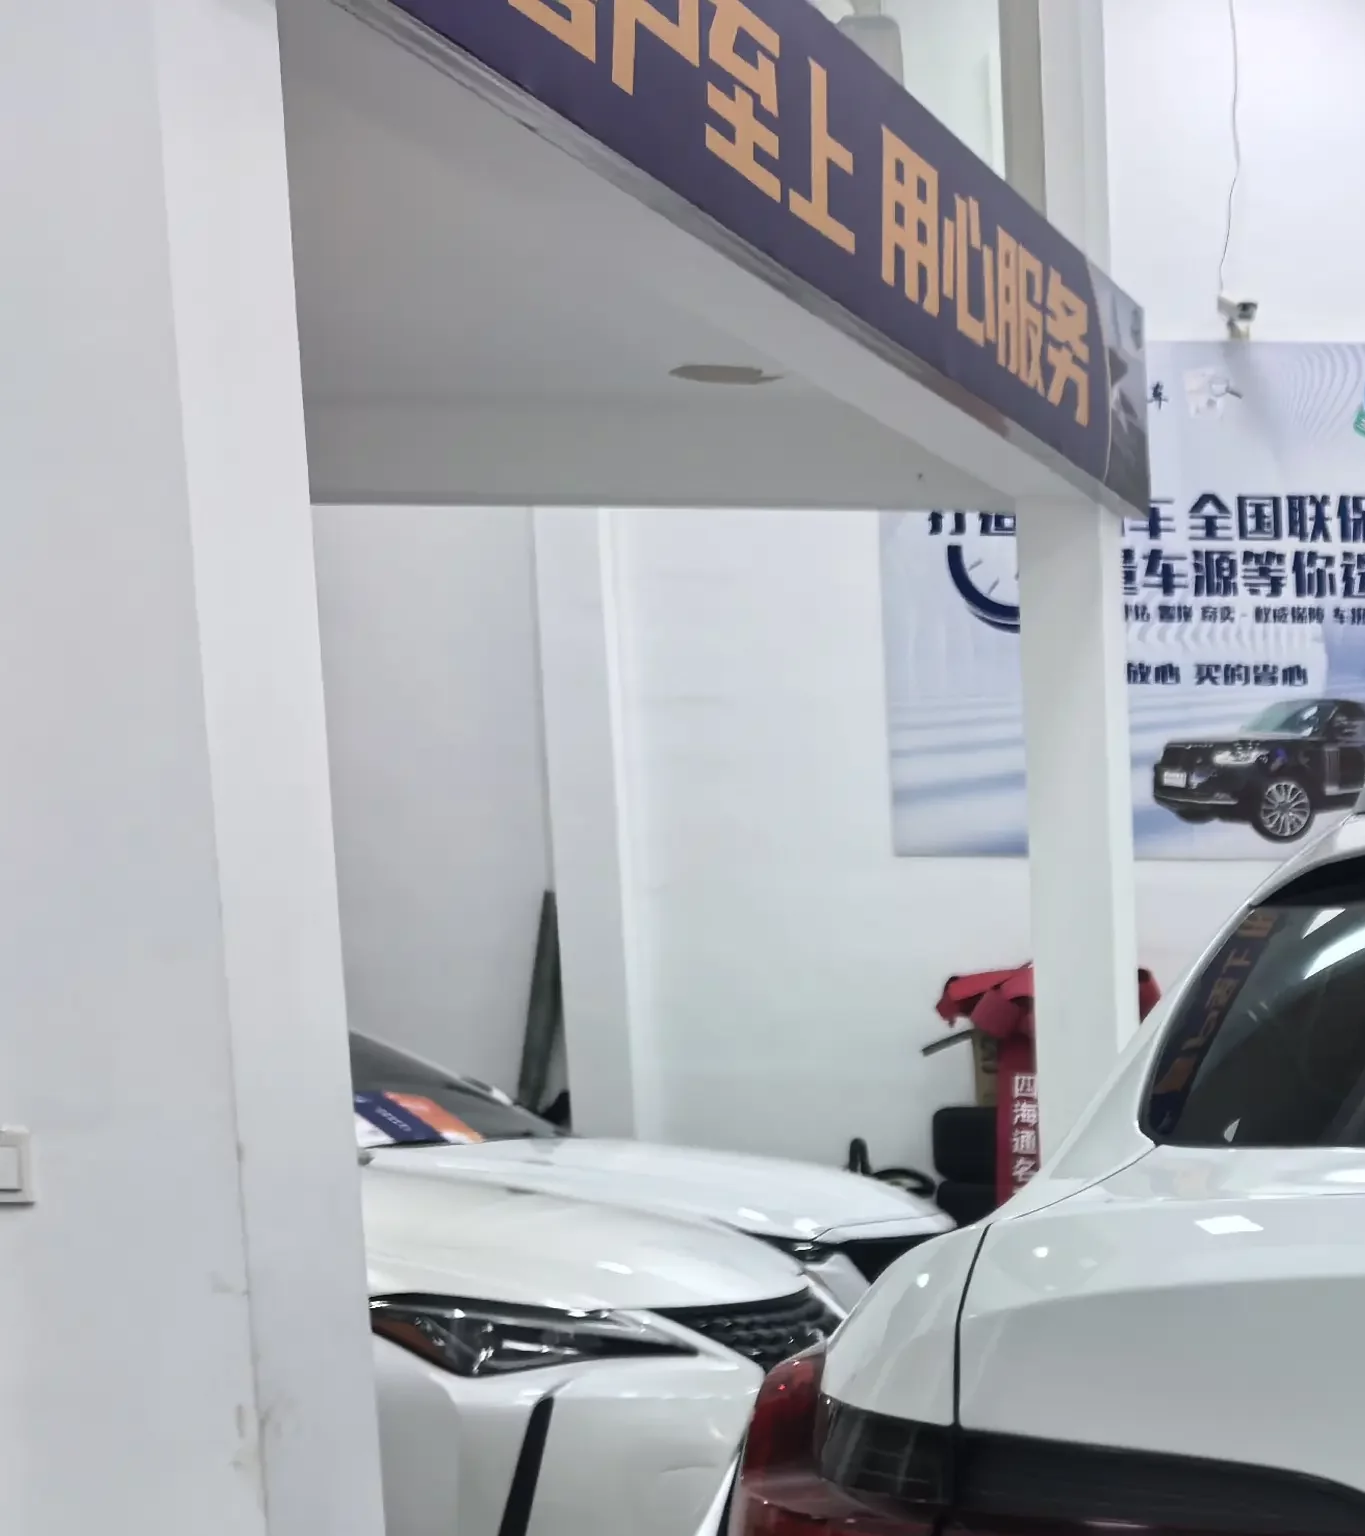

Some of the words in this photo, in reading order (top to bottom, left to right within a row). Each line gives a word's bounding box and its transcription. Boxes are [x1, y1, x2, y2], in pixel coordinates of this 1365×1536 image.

[881, 123, 1089, 428] 用心服务
[1012, 1073, 1038, 1190] 四海通名
